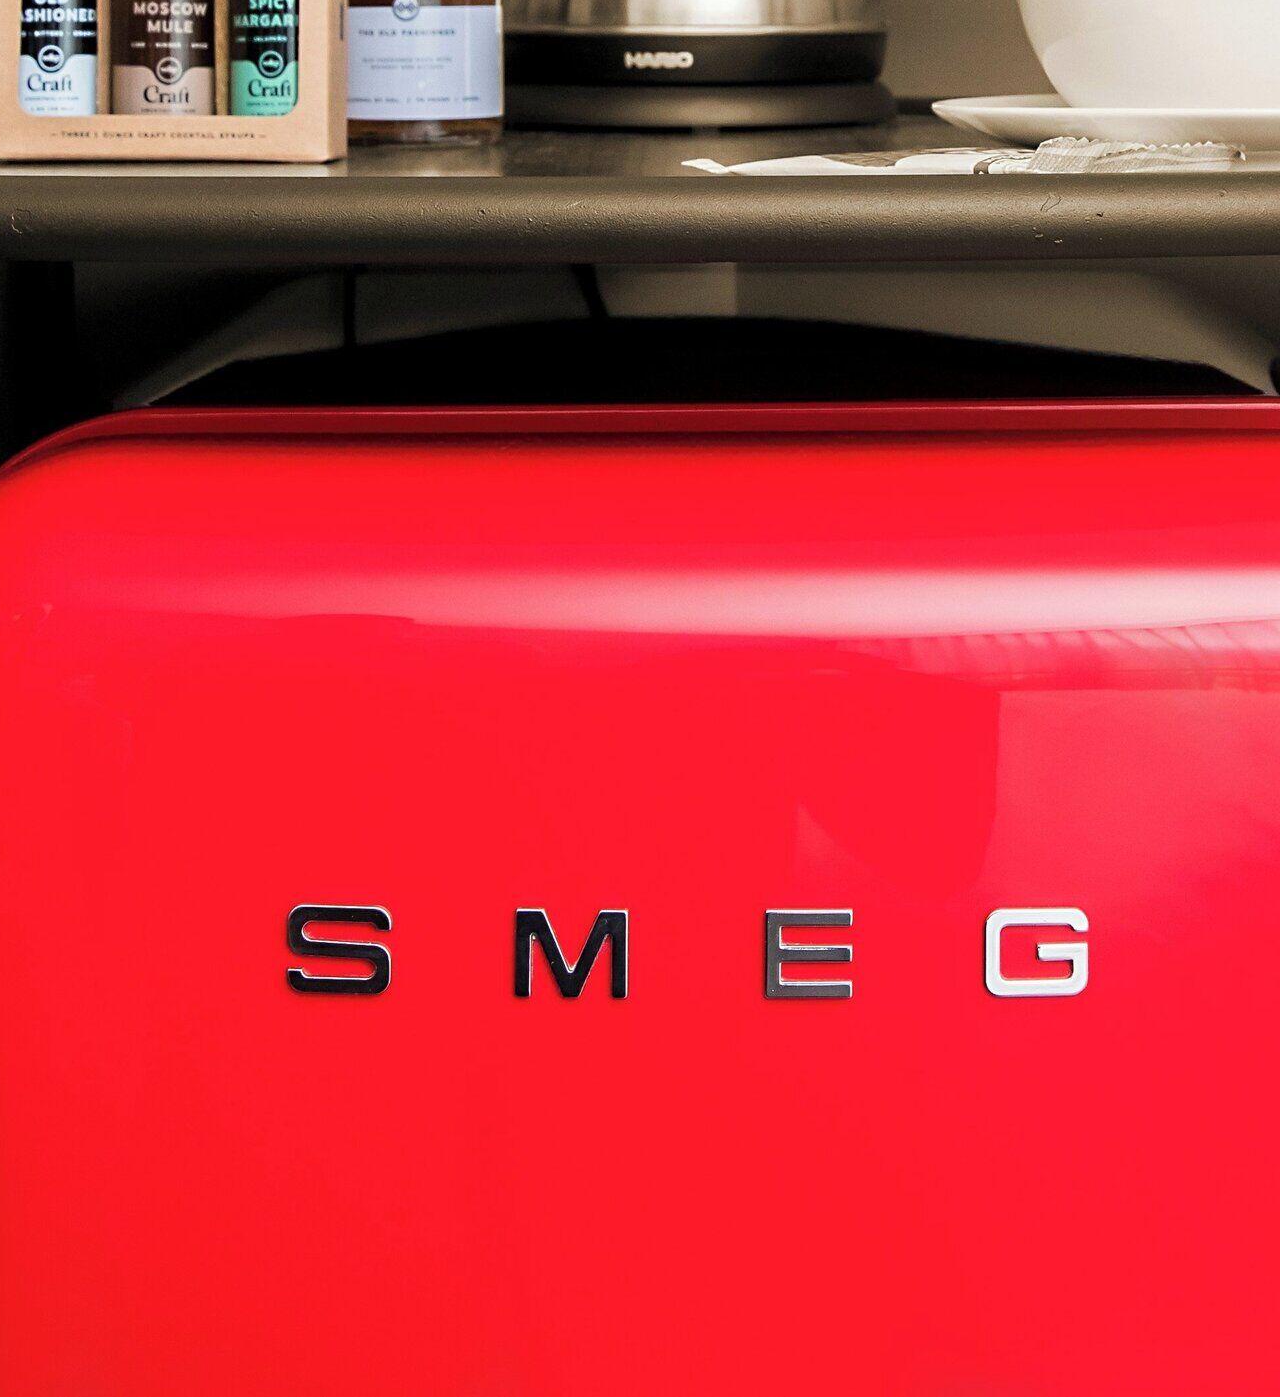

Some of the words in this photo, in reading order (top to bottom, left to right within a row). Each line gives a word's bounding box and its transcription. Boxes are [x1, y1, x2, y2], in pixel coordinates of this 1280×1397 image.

[20, 8, 96, 23] SHIONED
[133, 2, 207, 16] MOSCOW
[147, 20, 193, 33] MULE
[27, 73, 72, 92] Craft
[248, 79, 291, 97] Craft
[143, 85, 189, 103] Craft
[286, 903, 1089, 999] SMEG
